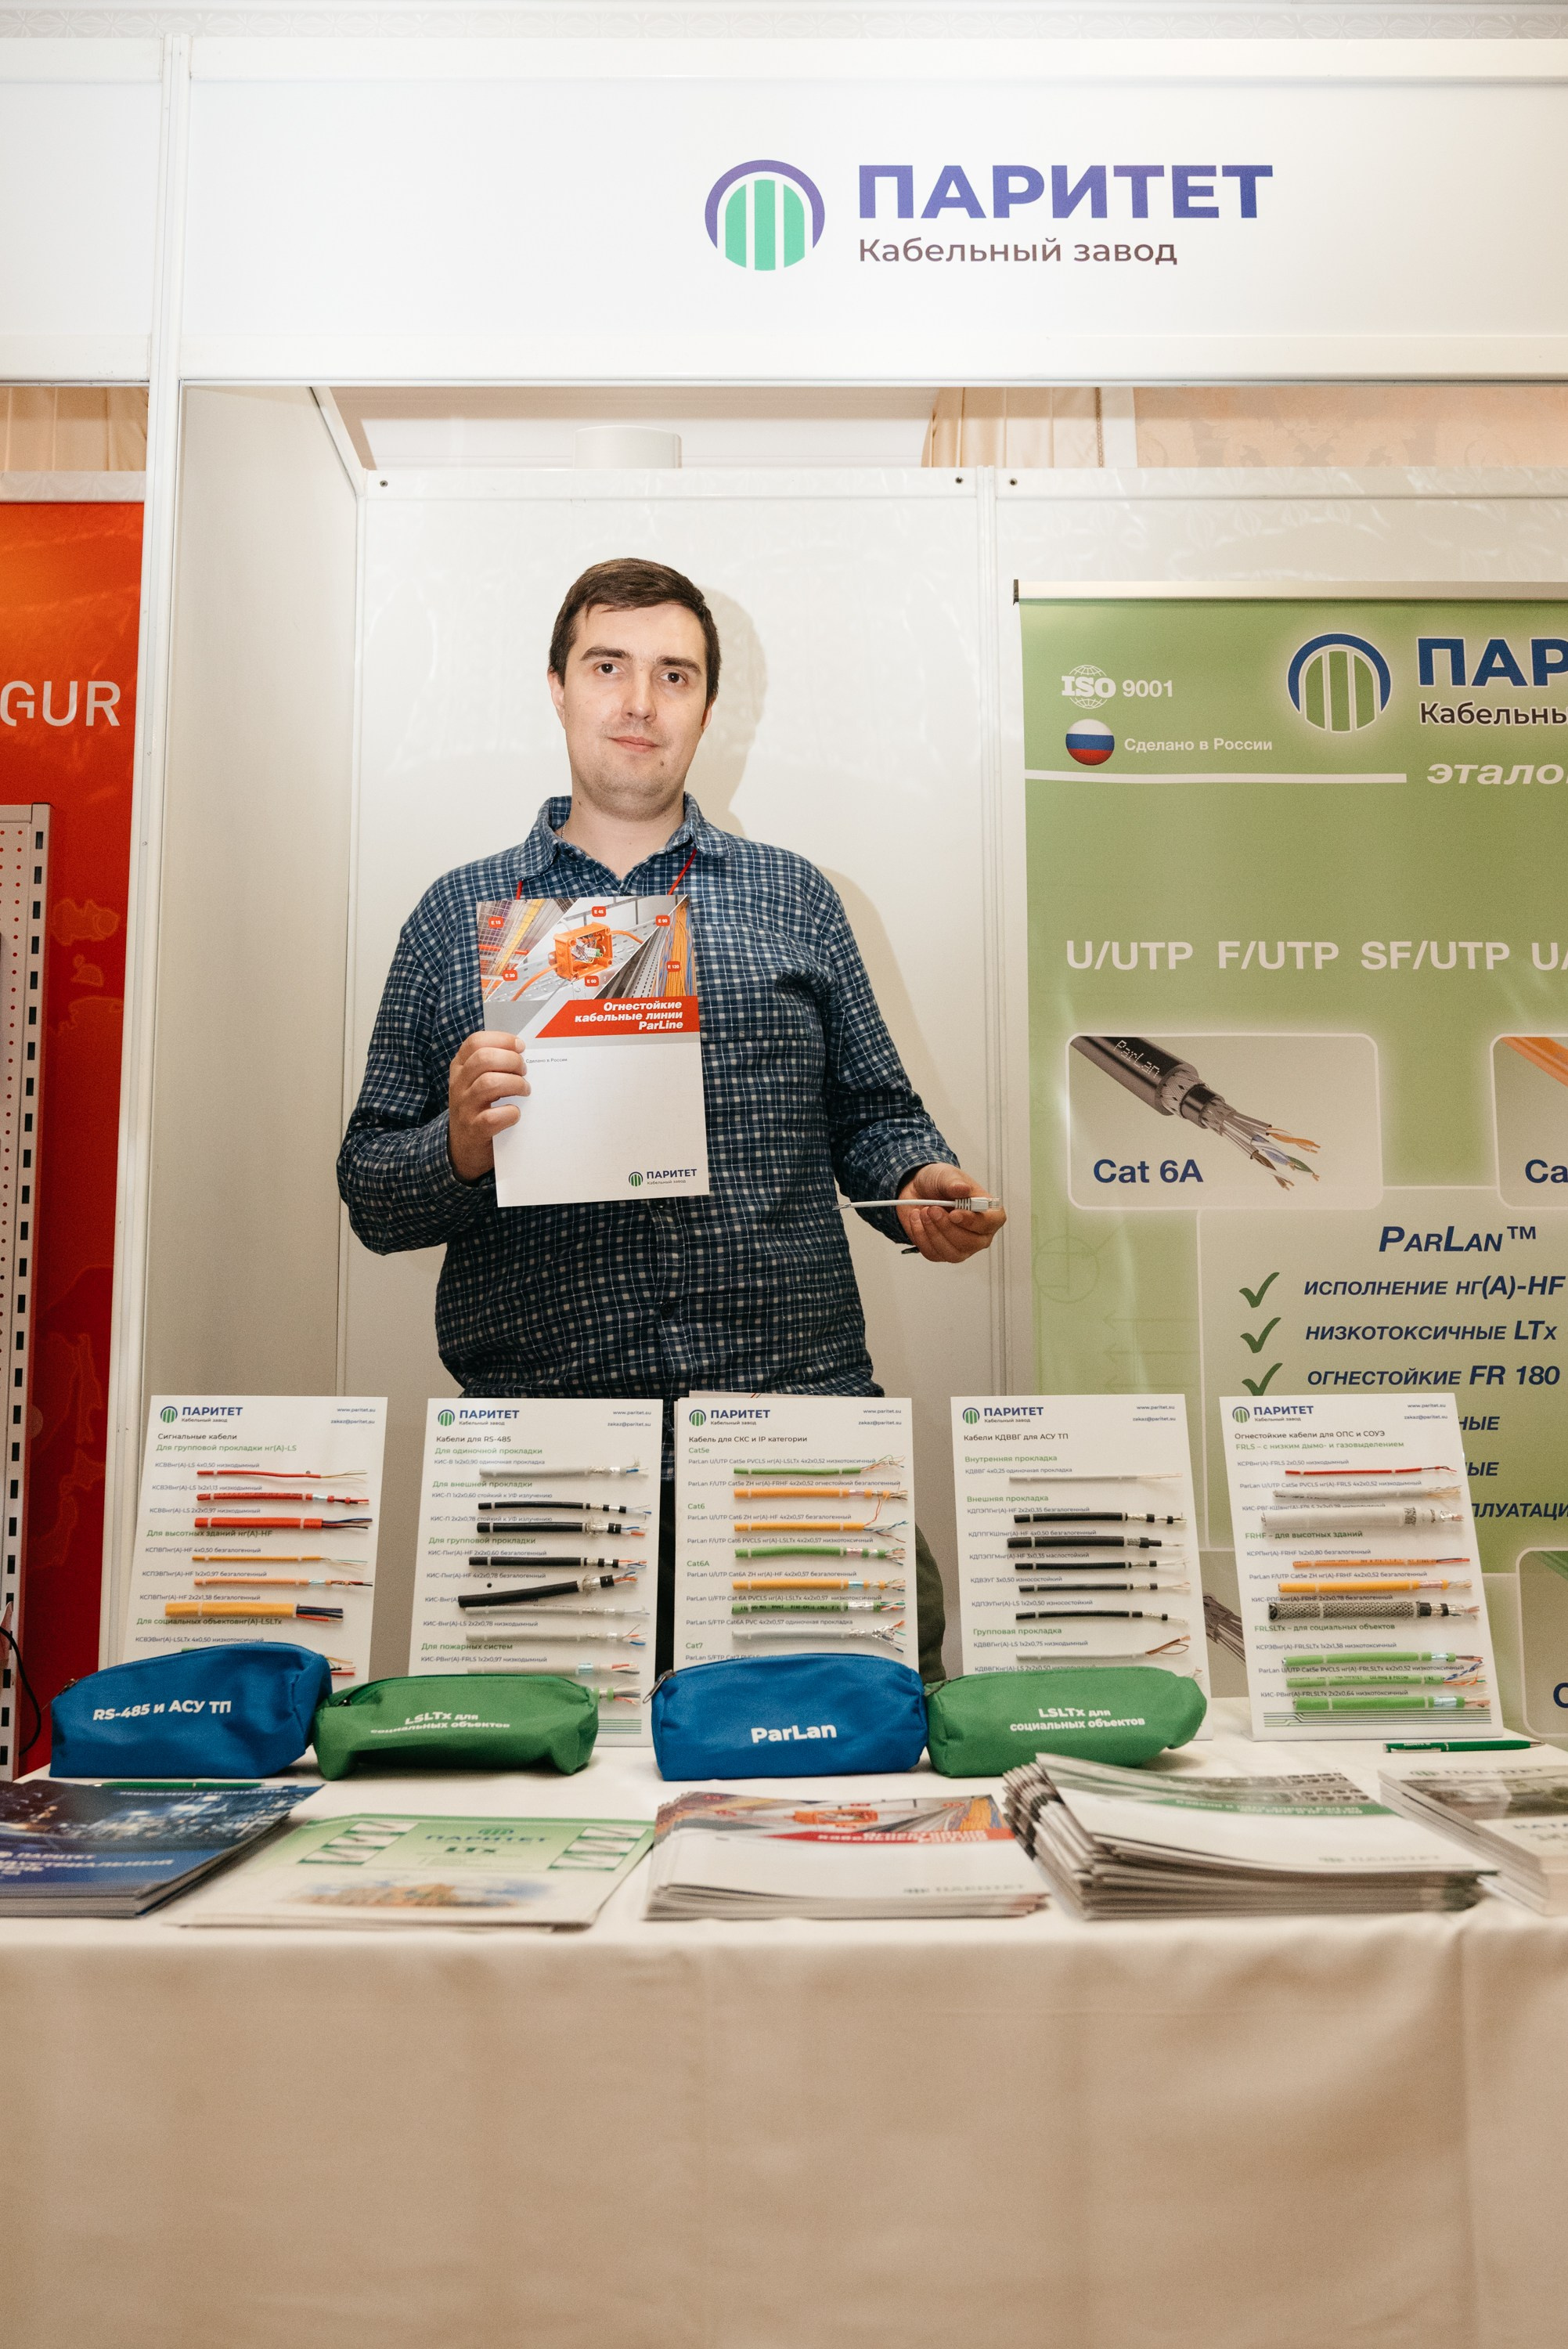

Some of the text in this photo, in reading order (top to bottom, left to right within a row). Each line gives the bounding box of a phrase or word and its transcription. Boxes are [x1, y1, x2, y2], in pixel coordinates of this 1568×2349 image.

[859, 164, 1273, 218] ПАРИТЕТ
[860, 237, 1177, 265] Кабельный завод
[1418, 638, 1568, 686] ПАР
[1062, 675, 1173, 698] ISO 9001
[0, 680, 121, 726] GUR
[1124, 738, 1272, 753] Сделано в России
[1427, 763, 1568, 785] этало
[1067, 941, 1193, 970] U/UTP
[1219, 941, 1339, 970] F/UTP
[1361, 941, 1510, 970] SF/UTP
[604, 1001, 682, 1012] Огнестойкие
[575, 1012, 642, 1022] кабельные
[639, 1021, 683, 1030] ParLine
[1113, 1040, 1159, 1077] ParLan
[647, 1169, 697, 1178] ПАРИТЕТ
[1094, 1160, 1203, 1183] Cat 6A
[182, 1407, 243, 1416] ПАРИТЕТ
[460, 1410, 520, 1419] ПАРИТЕТ
[711, 1409, 770, 1418] ПАРИТЕТ
[984, 1407, 1044, 1416] ПАРИТЕТ
[1254, 1405, 1314, 1415] ПАРИТЕТ
[1465, 1462, 1499, 1476] ЫЕ
[207, 1529, 236, 1538] зданий
[92, 1700, 232, 1721] RS-485 и АСУ ТП
[1039, 1708, 1111, 1718] LSLTx для
[405, 1712, 452, 1725] LSLTx
[1010, 1717, 1145, 1732] социальных объектов
[370, 1723, 448, 1734] социальных
[752, 1724, 837, 1744] ParLan
